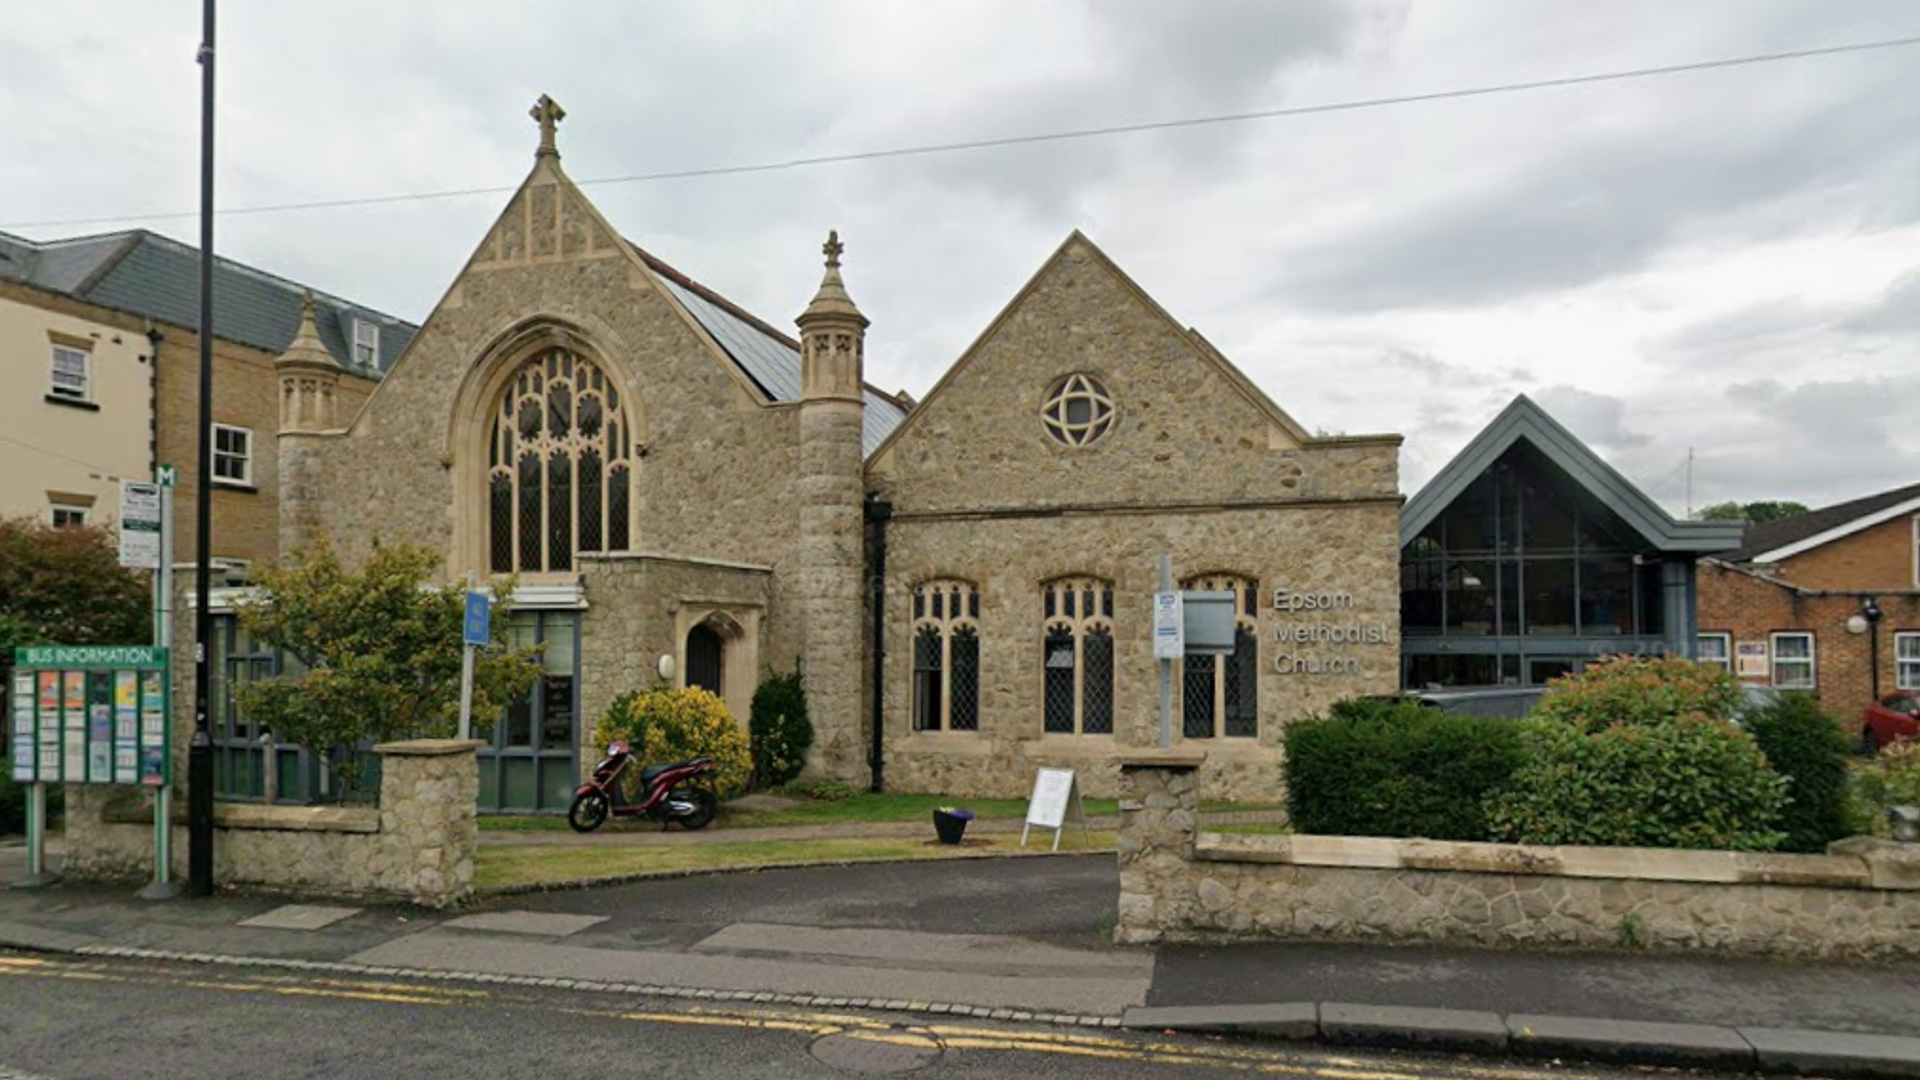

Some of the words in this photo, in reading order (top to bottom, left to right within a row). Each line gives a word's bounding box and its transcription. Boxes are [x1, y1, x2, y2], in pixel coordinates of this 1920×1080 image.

[157, 466, 174, 486] M
[1273, 589, 1354, 613] Epsom
[1273, 622, 1389, 643] Methodist
[27, 649, 54, 662] BUS
[56, 648, 153, 663] INFORMATION
[1274, 650, 1359, 674] Church
